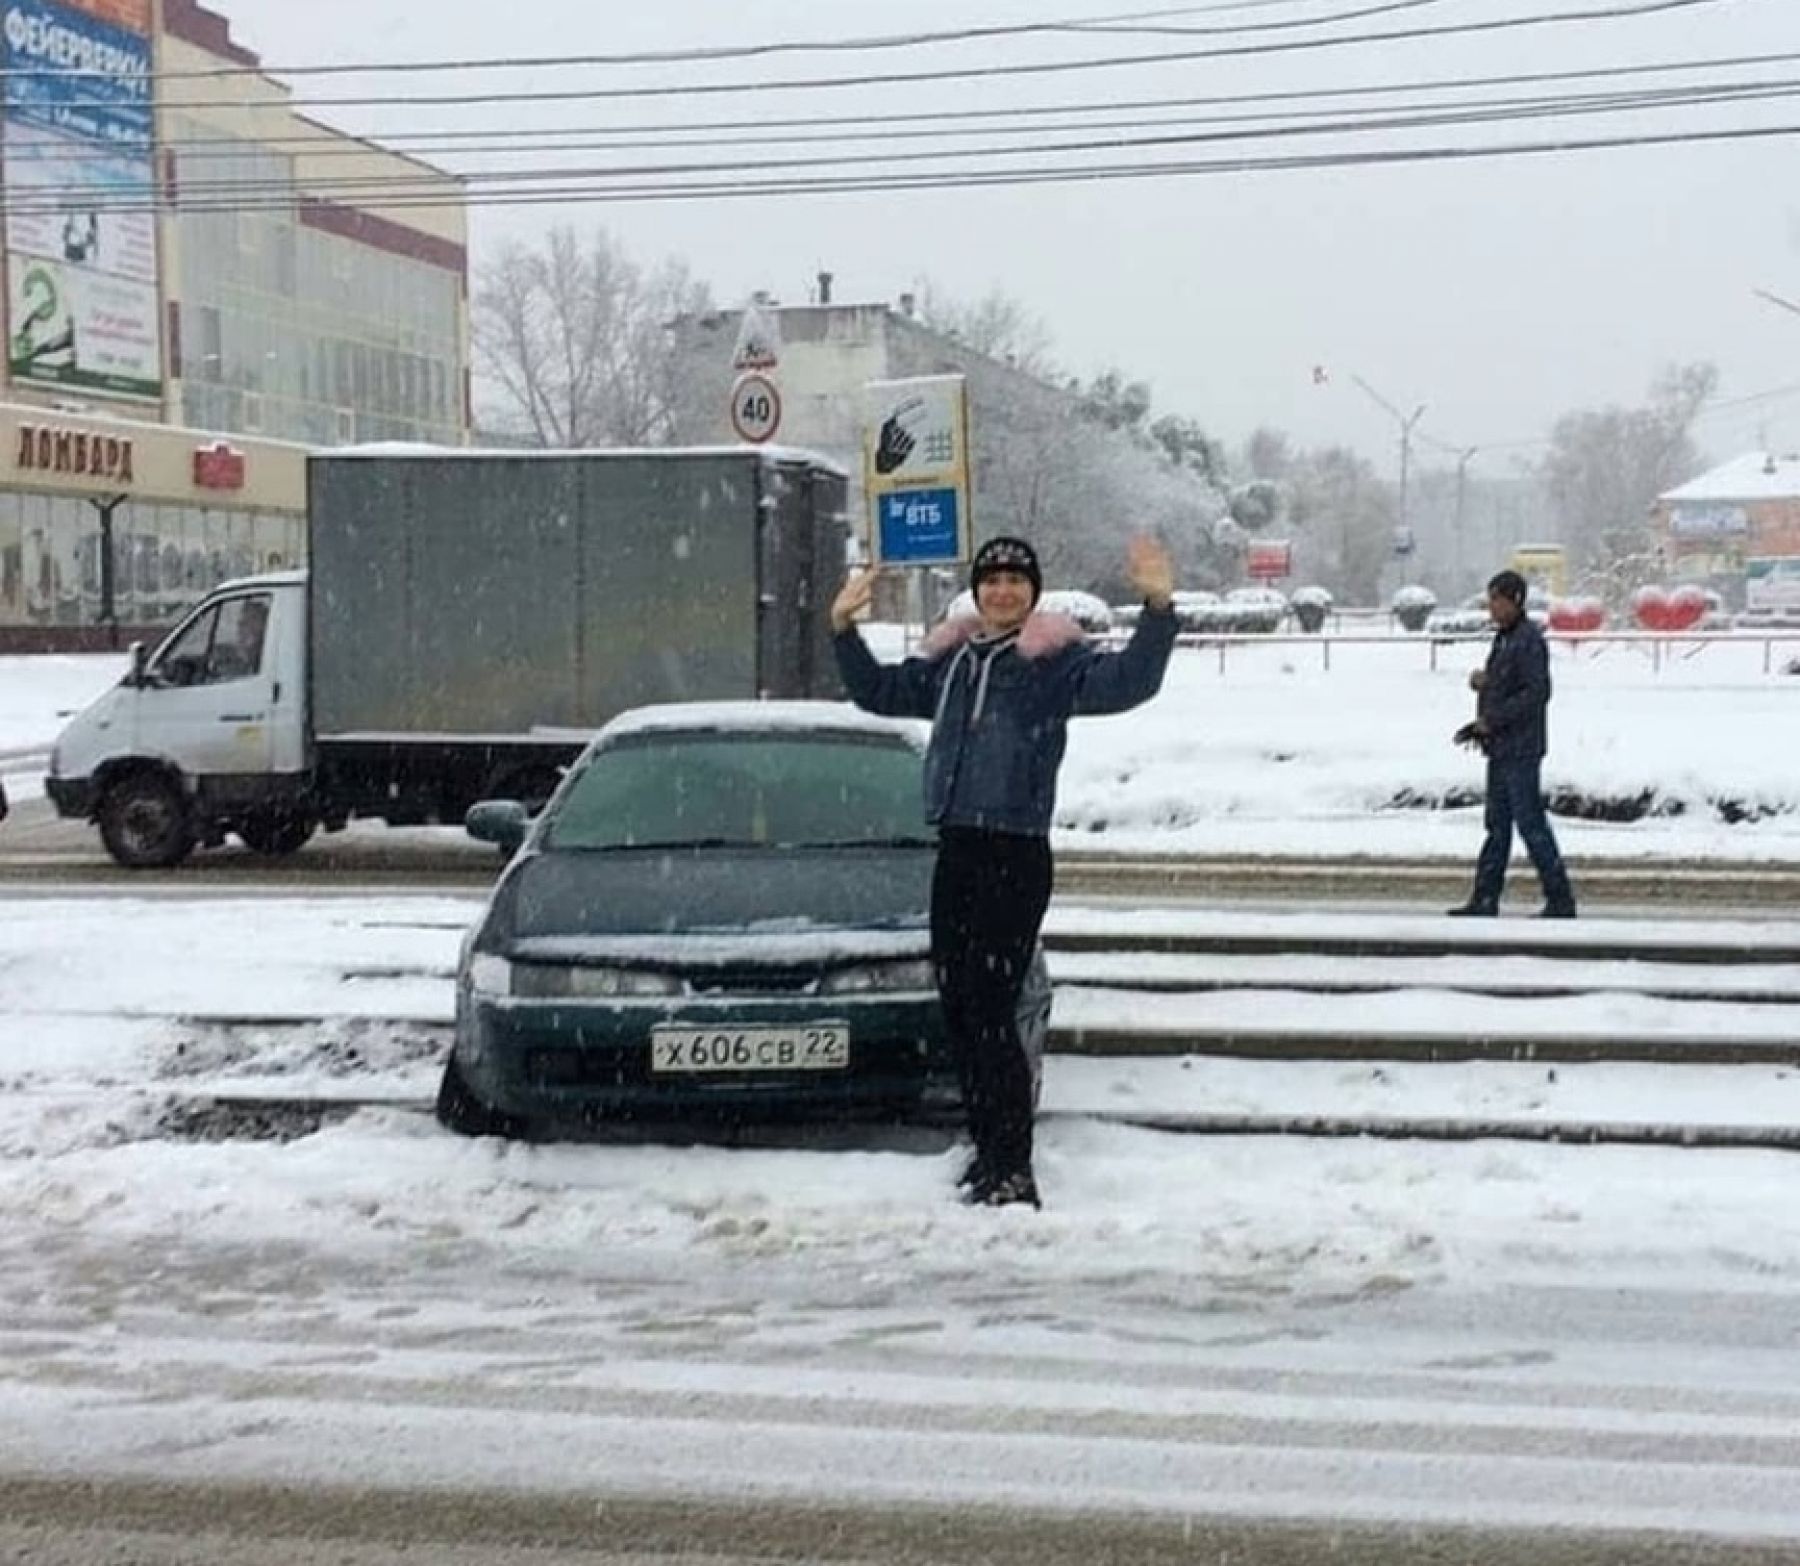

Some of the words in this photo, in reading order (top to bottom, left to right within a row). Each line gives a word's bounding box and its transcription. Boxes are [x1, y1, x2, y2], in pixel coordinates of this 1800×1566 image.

[742, 396, 771, 423] 40
[18, 426, 134, 483] ЛОМБАРД
[905, 502, 942, 525] ВТБ
[806, 1031, 837, 1055] 22
